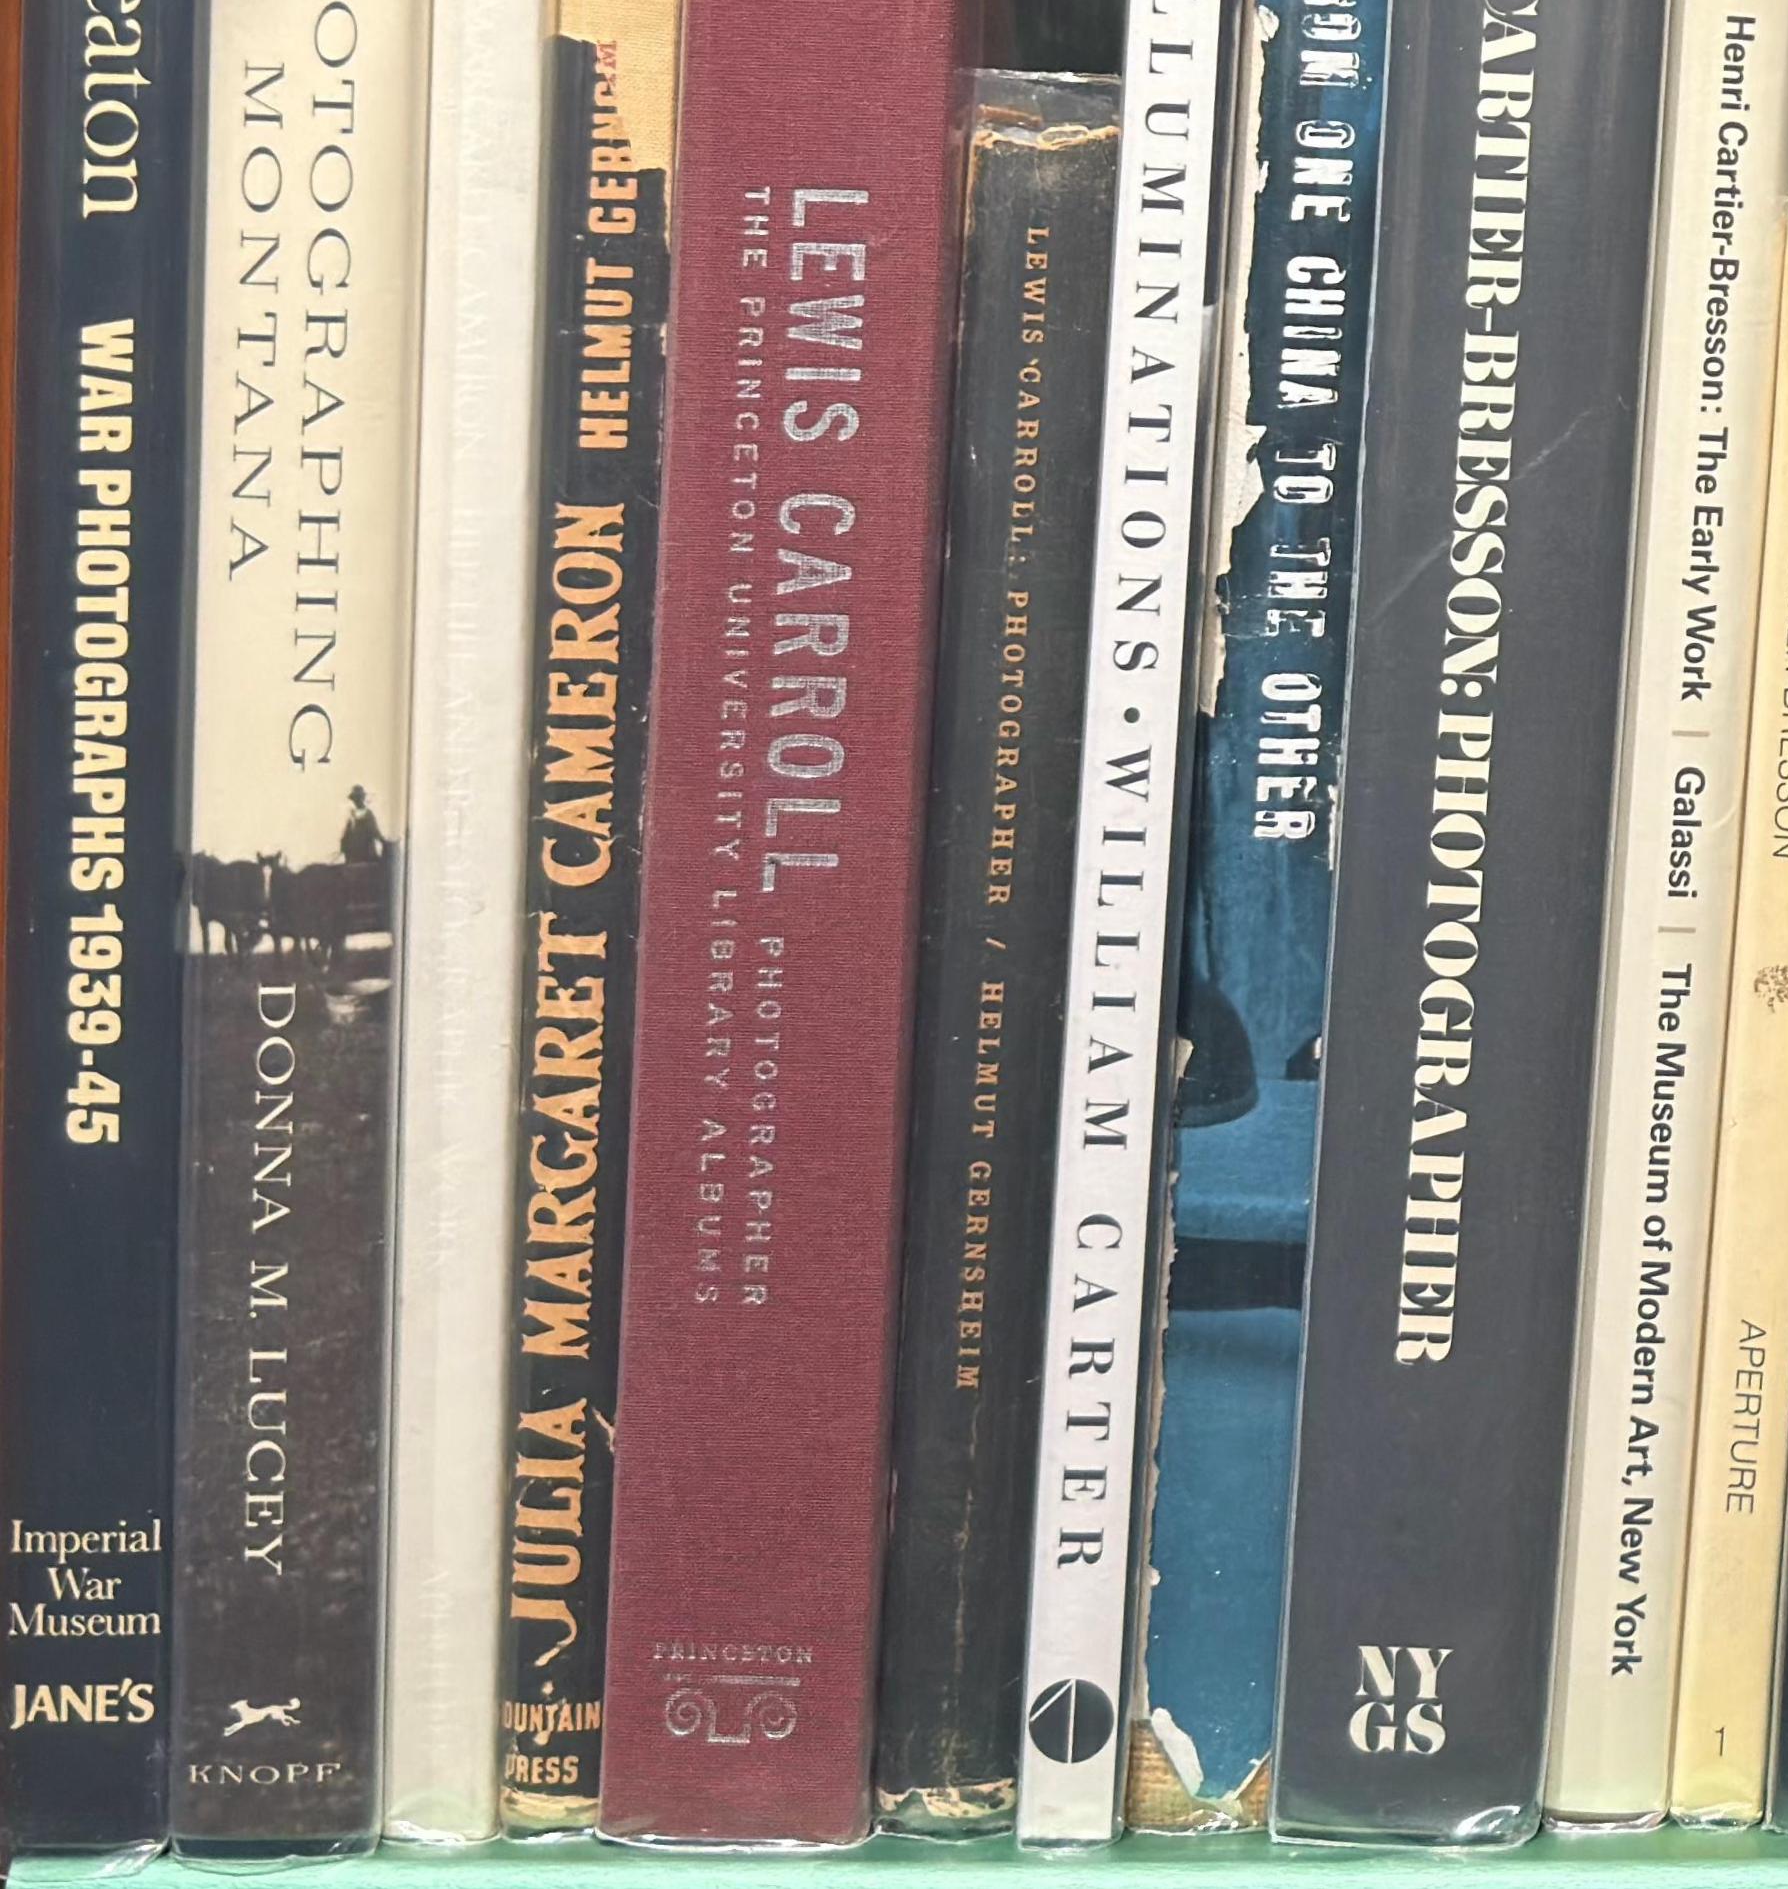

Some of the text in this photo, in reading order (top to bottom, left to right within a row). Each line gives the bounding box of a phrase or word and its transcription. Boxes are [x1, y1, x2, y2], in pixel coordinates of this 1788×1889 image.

[228, 60, 286, 581] MONTANA
[1020, 226, 1050, 346] LEWIS
[694, 187, 771, 1305] THE PRINCETON UNIVERSITY LIBRARY ALBUMS
[987, 591, 1029, 906] PHOTOGRAPHER
[1611, 14, 1757, 1676] Henri Cartier-Bresson: The Early Work Galassi The Museum of Modern Art, New York
[509, 257, 635, 1666] JULIA MARGARET CAMERON HELMUT
[1083, 744, 1154, 1149] WILLIAM
[970, 981, 1004, 1139] HELMUT
[244, 983, 297, 1575] DONNA M. LUCEY
[957, 1161, 992, 1389] GERNSHEIM
[1056, 1213, 1123, 1569] CARTER
[1726, 1320, 1767, 1514] APERTURE
[9, 1602, 162, 1638] Museum
[10, 1518, 162, 1562] Imperial
[48, 1567, 121, 1601] War
[10, 1677, 154, 1728] JANE'S
[653, 1641, 813, 1663] PRINCETON
[1348, 1703, 1447, 1756] GS
[1357, 1645, 1454, 1700] NY
[189, 1762, 341, 1785] KNOPF
